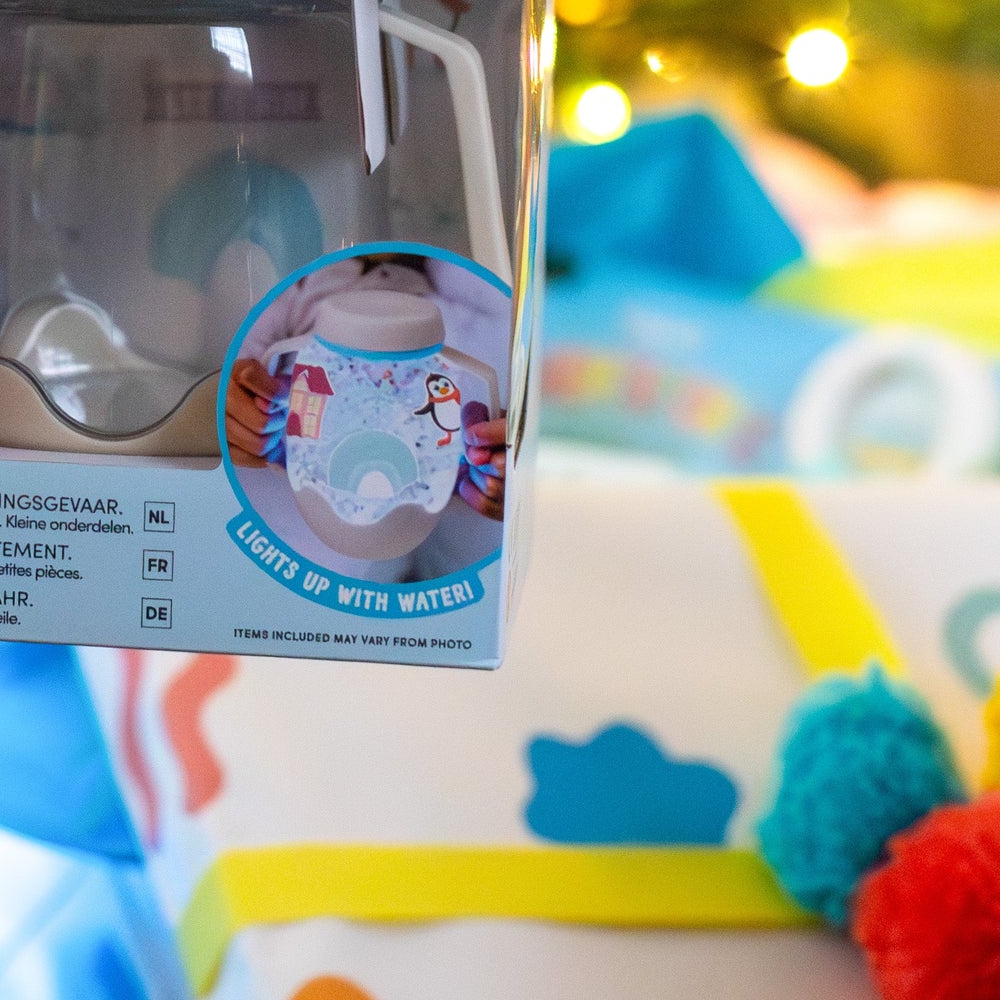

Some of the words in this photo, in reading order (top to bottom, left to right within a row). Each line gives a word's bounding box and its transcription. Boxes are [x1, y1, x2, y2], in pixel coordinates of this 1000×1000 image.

[6, 515, 46, 530] Kleine
[49, 518, 134, 535] onderdelen.
[148, 510, 170, 525] NL
[35, 565, 83, 581] pièces.
[147, 558, 168, 573] FR
[236, 520, 300, 580] LIGHTS
[302, 570, 330, 595] UP
[338, 584, 388, 612] WITH
[397, 580, 474, 613] WATER!
[146, 606, 168, 621] DE
[233, 628, 269, 640] ITEMS
[272, 630, 330, 643] INCLUDED
[334, 633, 357, 645] MAY
[361, 635, 390, 646] VARY
[393, 637, 427, 648] FROM
[431, 638, 472, 650] PHOTO
